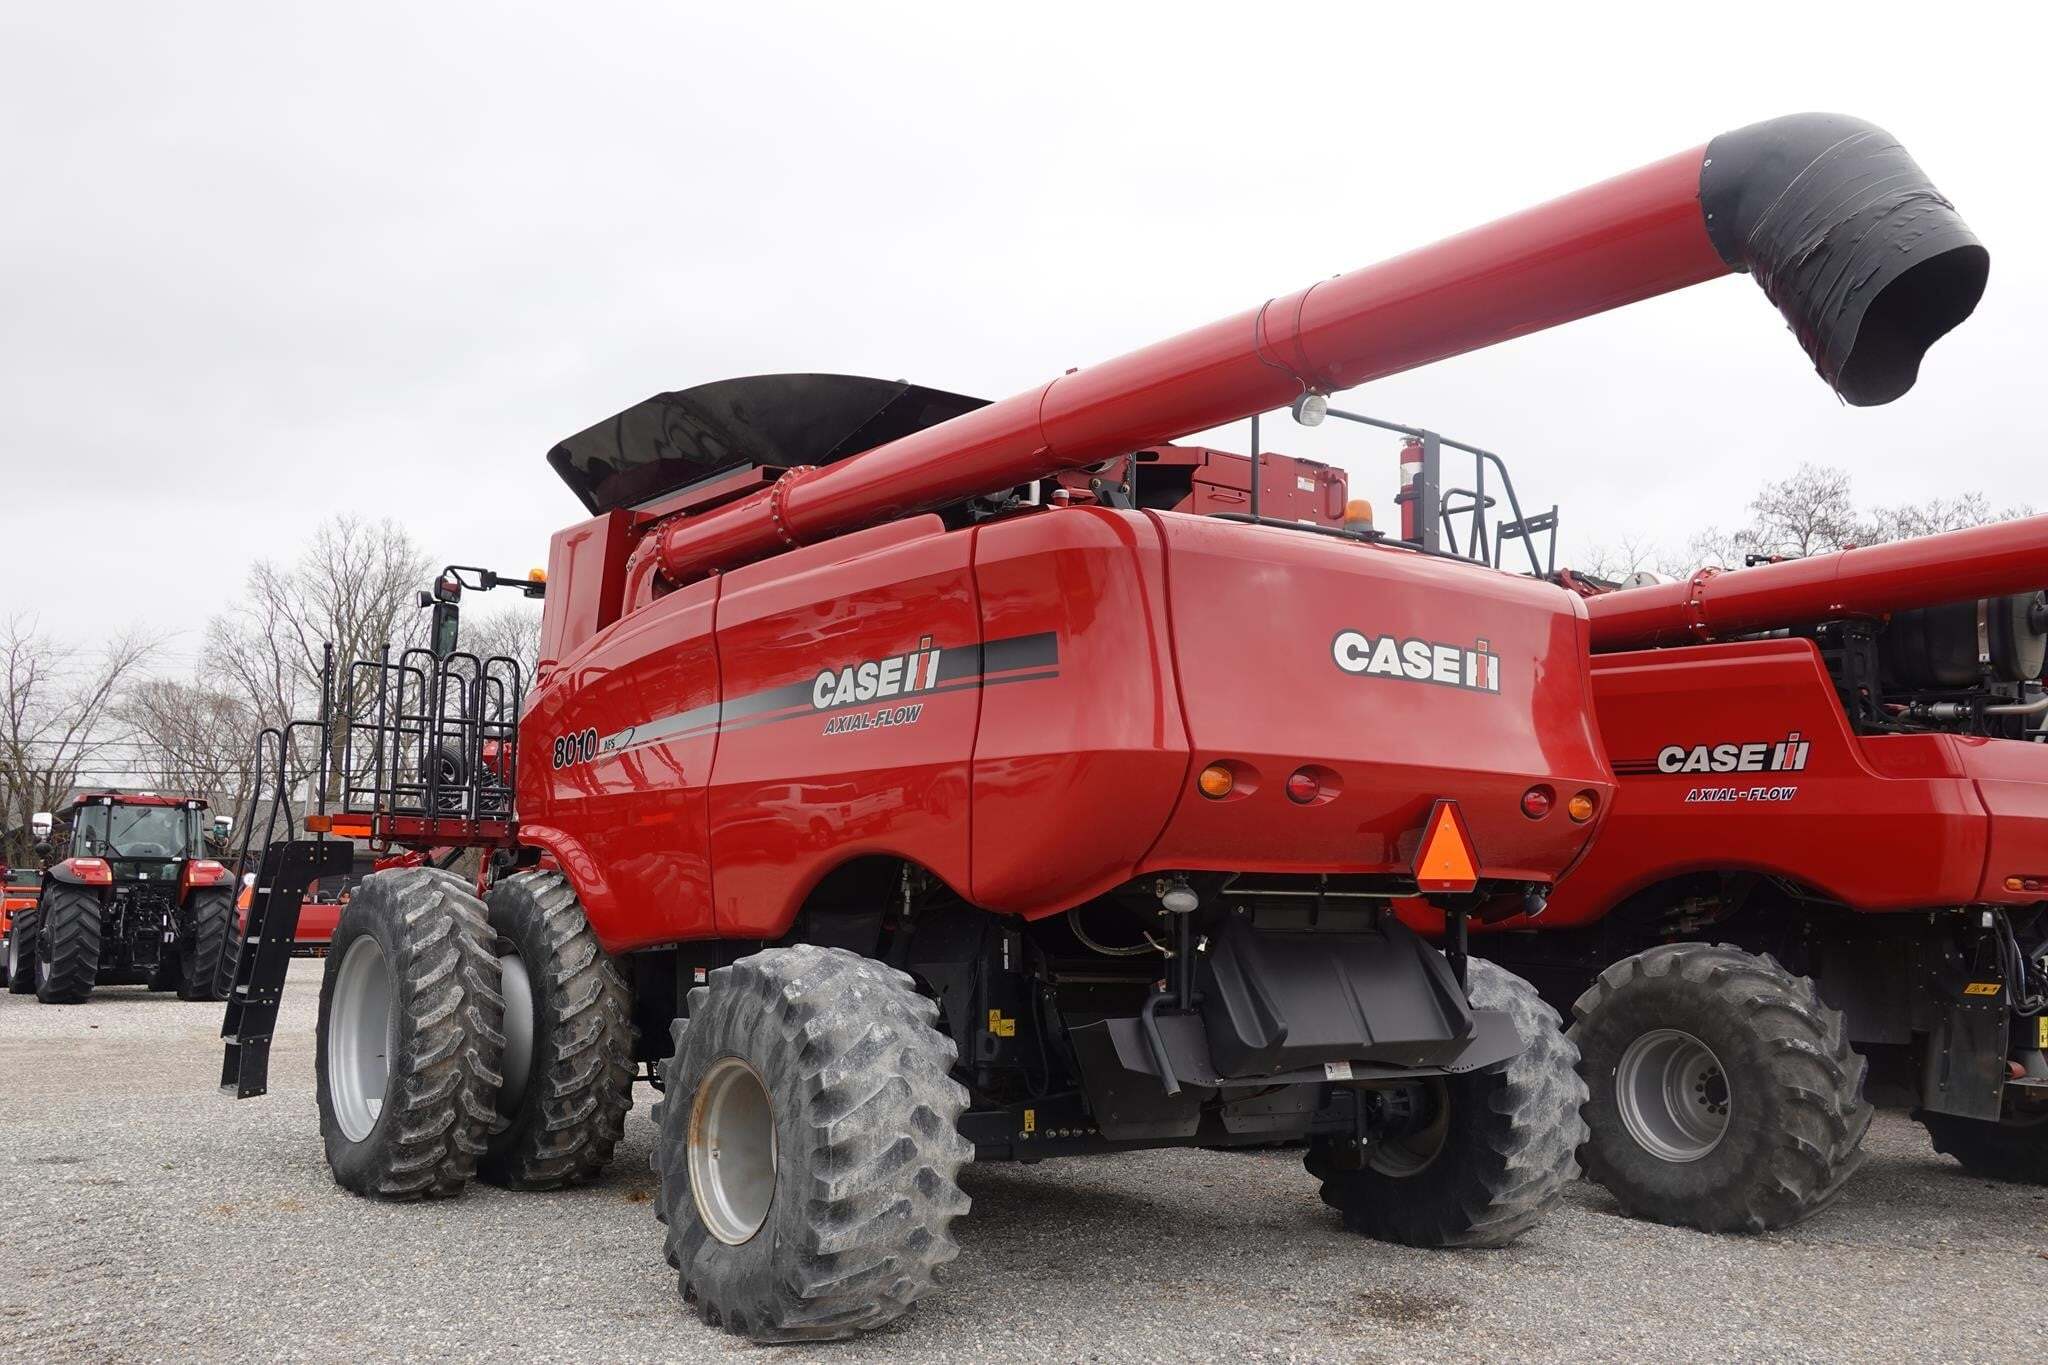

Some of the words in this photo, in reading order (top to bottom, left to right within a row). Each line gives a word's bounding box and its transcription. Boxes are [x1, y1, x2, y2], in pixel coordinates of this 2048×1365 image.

[1334, 632, 1460, 684] CASE
[813, 657, 903, 709] CASE
[823, 703, 923, 736] AXIAL-FLOW
[553, 727, 598, 770] 8010
[1657, 744, 1767, 773] CASE
[1684, 787, 1797, 802] AXIAL-FLOW
